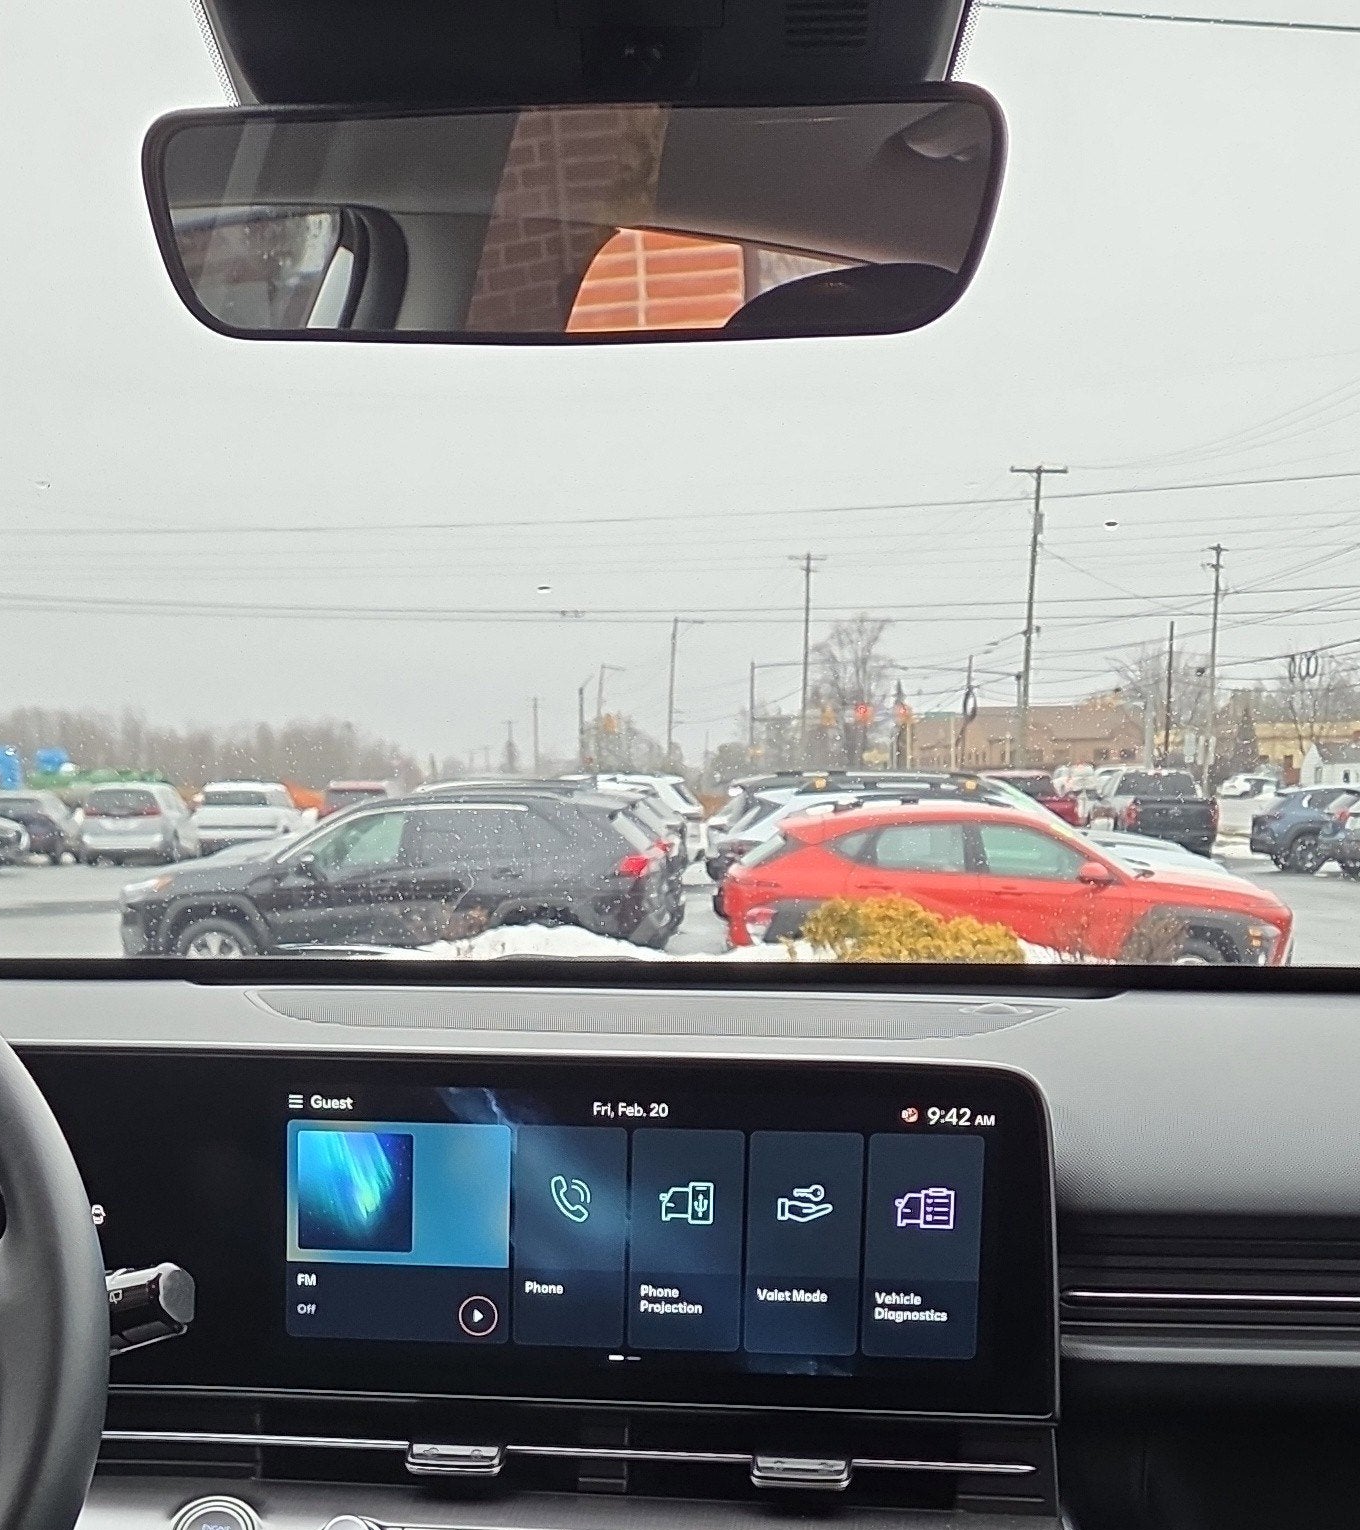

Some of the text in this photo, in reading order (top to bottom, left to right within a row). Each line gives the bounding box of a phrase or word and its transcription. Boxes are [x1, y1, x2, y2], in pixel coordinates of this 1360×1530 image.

[310, 1094, 354, 1111] Guest
[593, 1101, 669, 1119] Fri, Feb. 20
[927, 1106, 996, 1127] 9:42 AM
[296, 1273, 317, 1288] FM
[524, 1280, 564, 1295] Phone
[639, 1284, 680, 1299] Phone
[756, 1287, 829, 1303] Valet Mode
[874, 1291, 923, 1306] Vehicle
[296, 1303, 317, 1315] Off
[639, 1300, 703, 1315] Projection
[874, 1307, 949, 1323] Diagnostics
